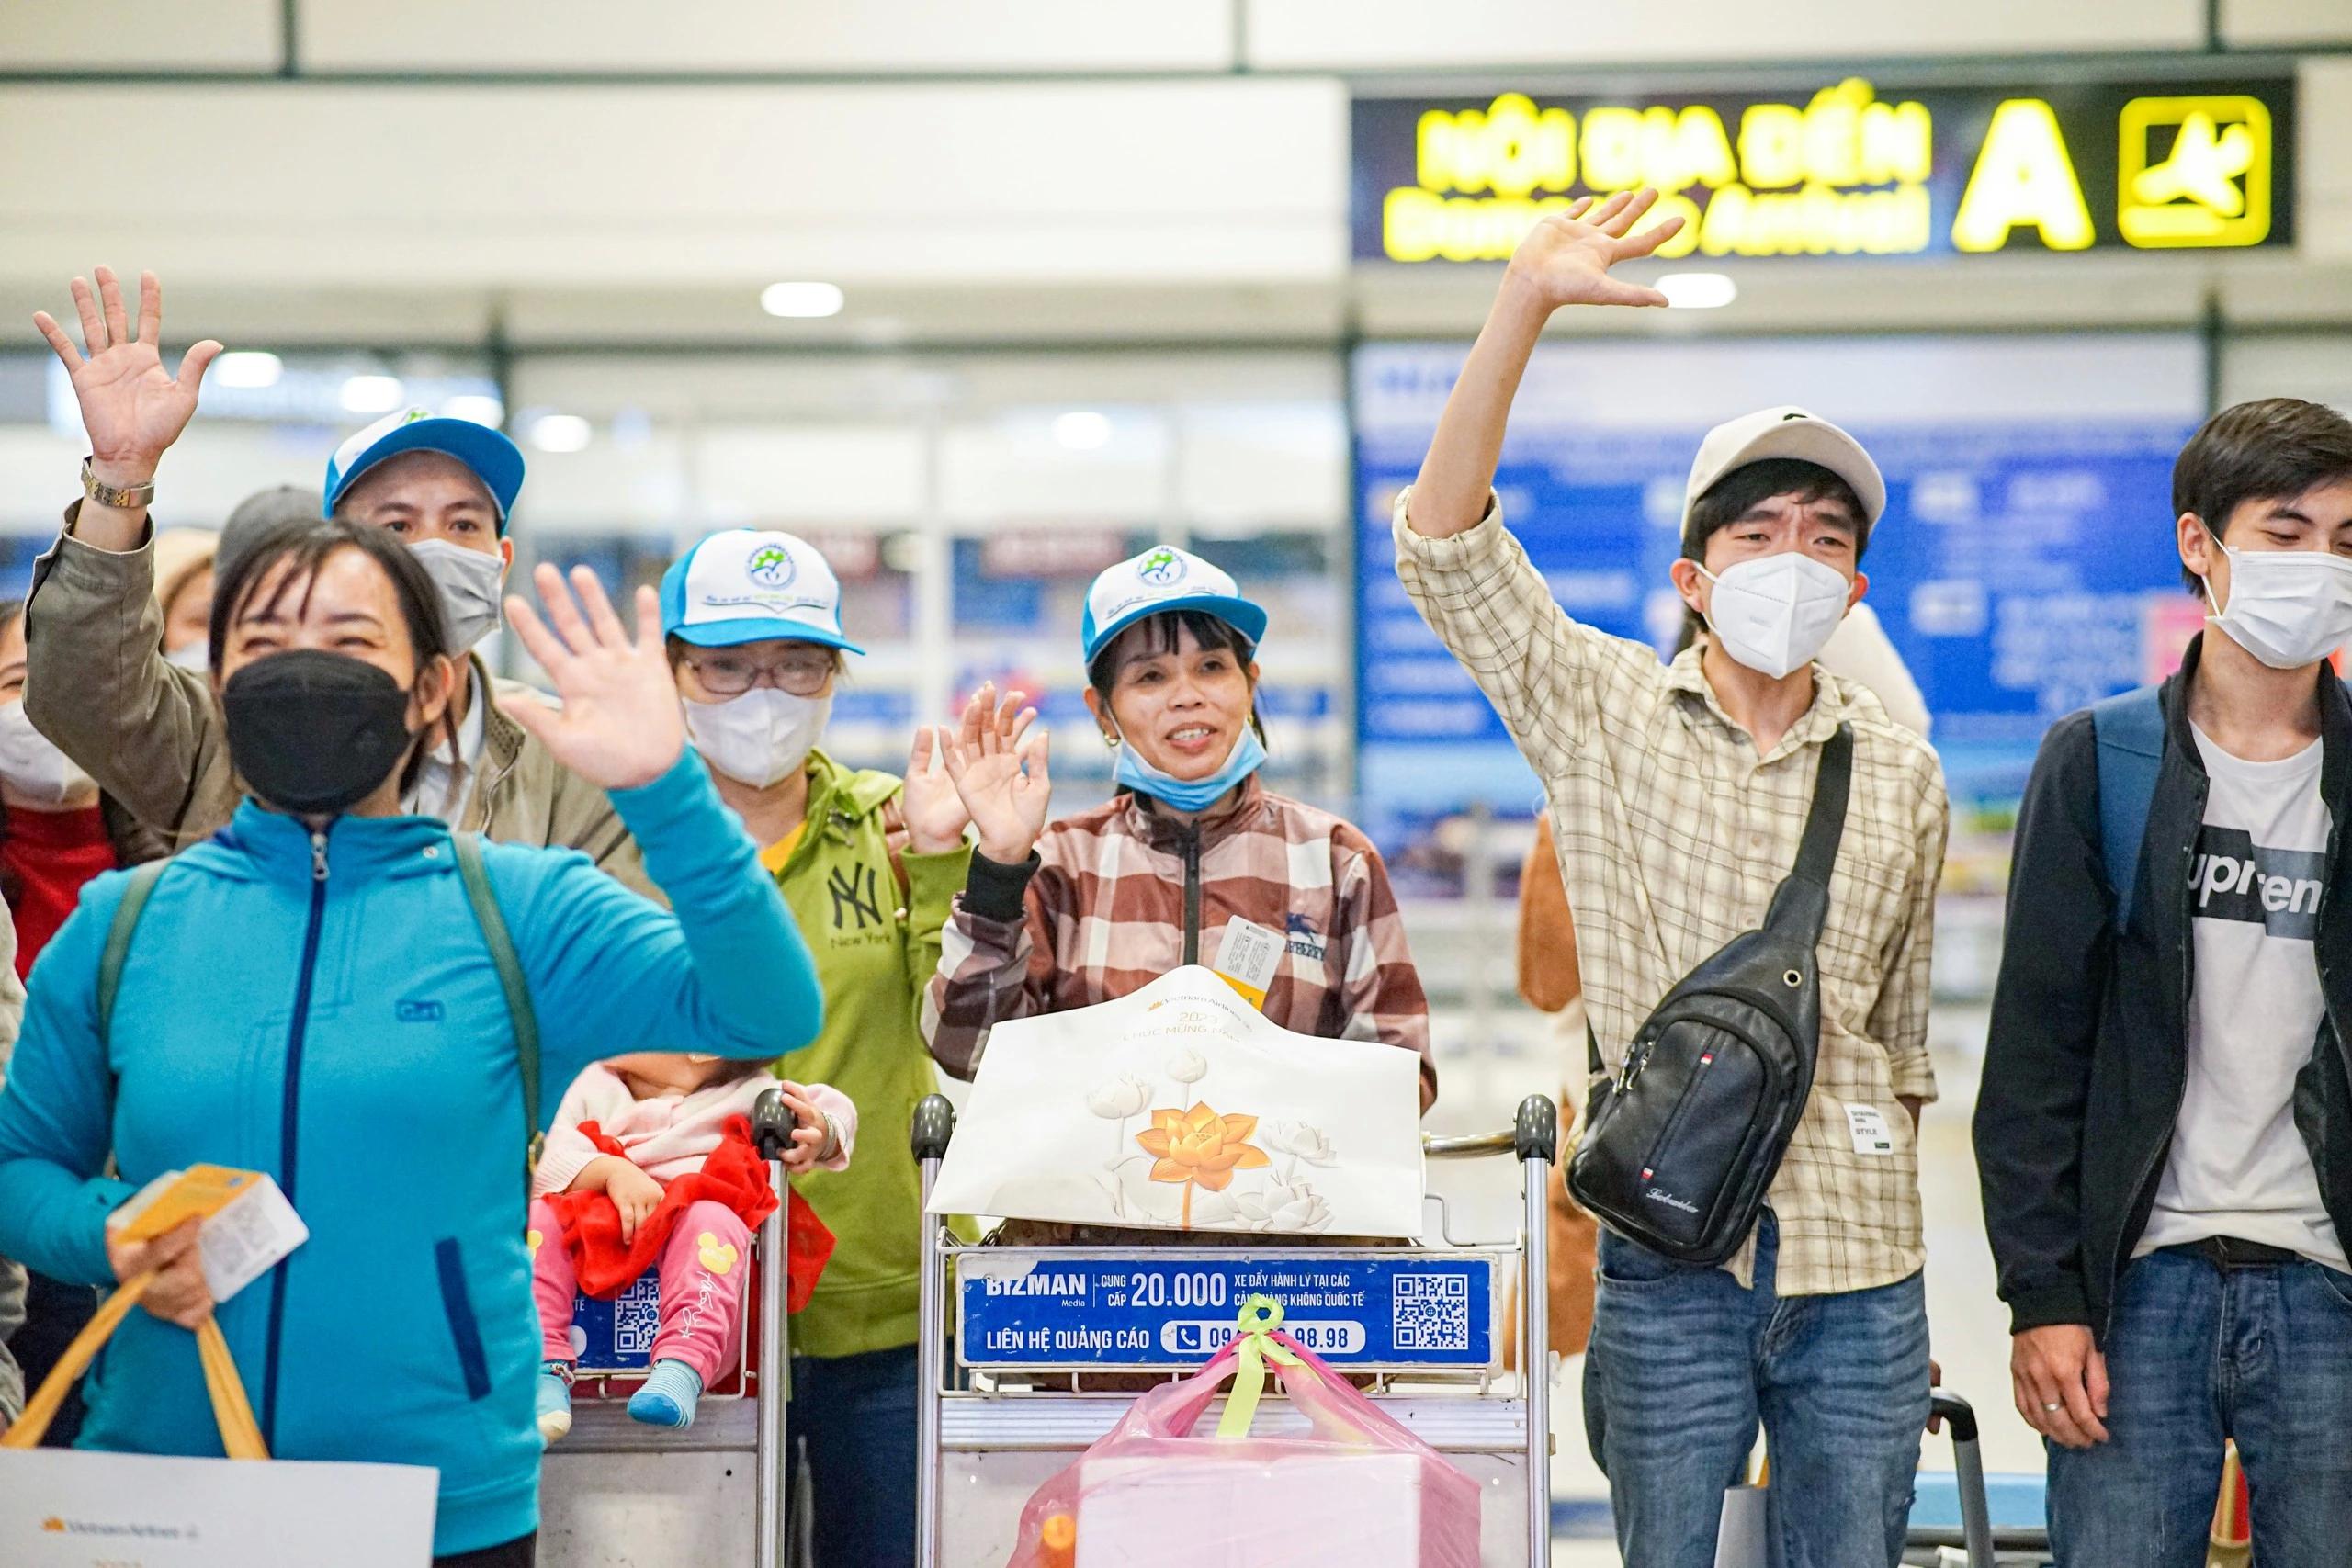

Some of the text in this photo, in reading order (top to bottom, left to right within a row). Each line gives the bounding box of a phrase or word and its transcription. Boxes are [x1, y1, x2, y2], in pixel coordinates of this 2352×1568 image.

[1951, 98, 2096, 253] A
[986, 1273, 1086, 1296] BIZMAN
[1101, 1274, 1126, 1287] CUNG
[1234, 1274, 1247, 1287] XE
[1271, 1272, 1296, 1287] HÀNH
[1299, 1272, 1311, 1287] LÝ
[1313, 1273, 1329, 1289] TẠI
[1330, 1272, 1350, 1287] CÁC
[1131, 1272, 1227, 1307] 20.000
[1061, 1298, 1086, 1307] Media
[1107, 1291, 1126, 1307] CẤP
[1290, 1292, 1323, 1307] KHÔNG
[1324, 1290, 1350, 1307] QUỐC
[1351, 1290, 1365, 1307] TẾ
[986, 1325, 1150, 1353] LIÊN HỆ QUẢNG CÁO
